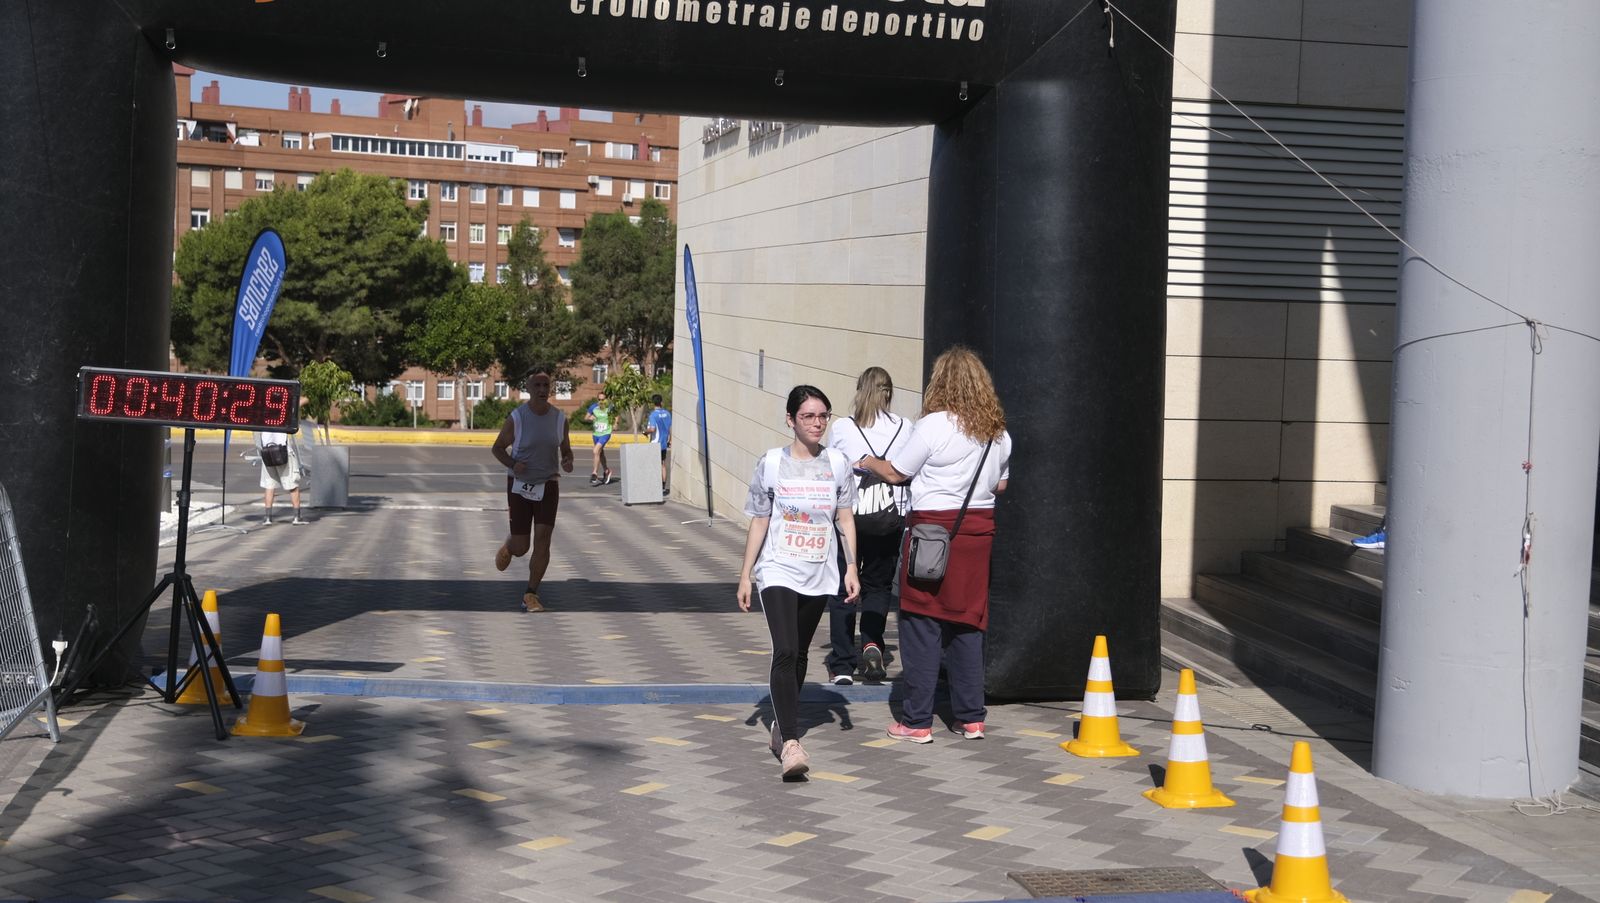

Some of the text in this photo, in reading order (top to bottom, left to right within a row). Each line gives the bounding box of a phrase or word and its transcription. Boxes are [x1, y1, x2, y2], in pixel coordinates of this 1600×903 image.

[570, 0, 985, 42] cronometraje deportivo
[89, 374, 289, 426] 00:40:29
[521, 483, 536, 492] 47
[858, 482, 895, 516] NIKE
[784, 534, 826, 549] 1049
